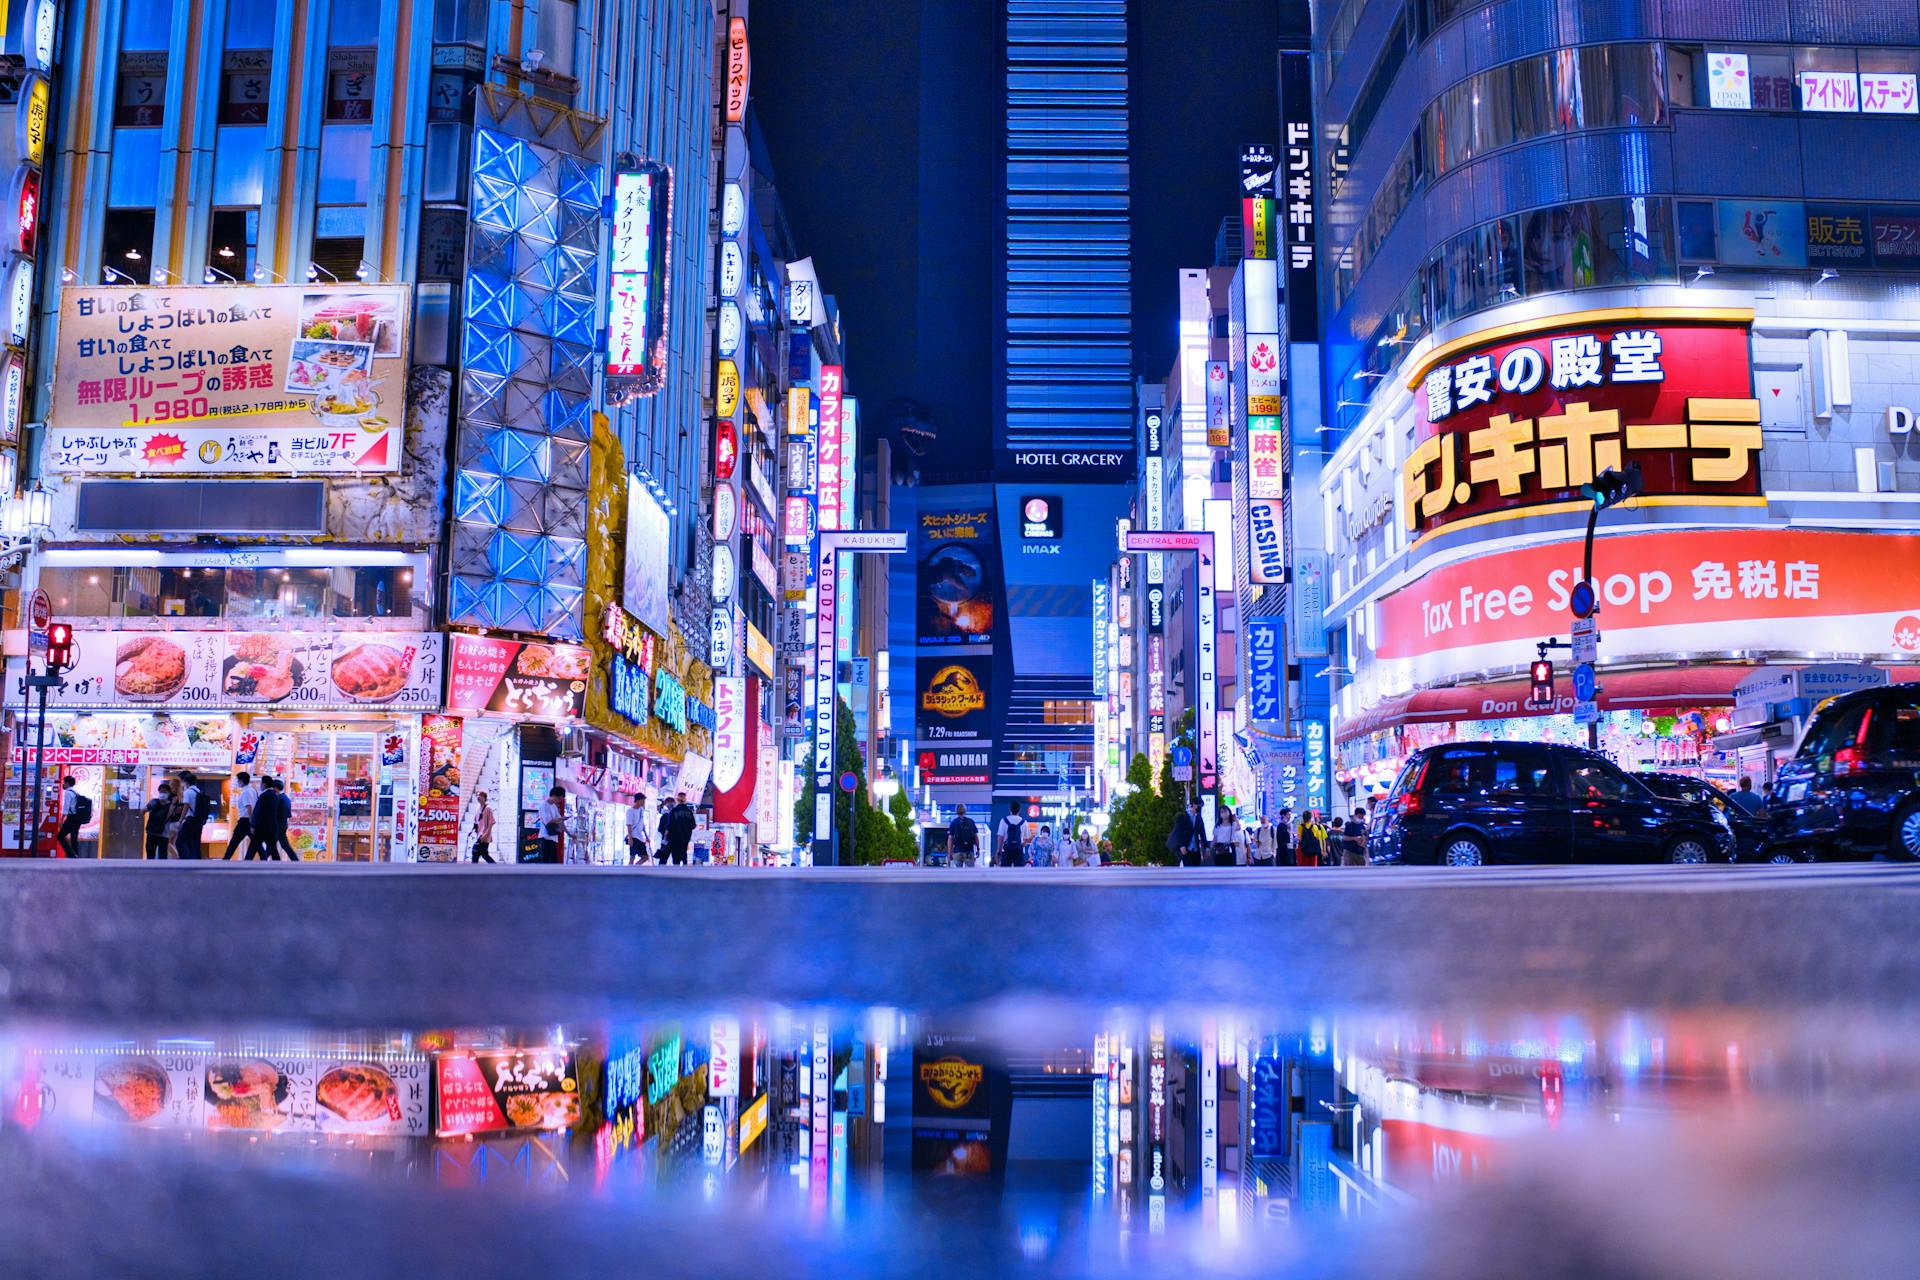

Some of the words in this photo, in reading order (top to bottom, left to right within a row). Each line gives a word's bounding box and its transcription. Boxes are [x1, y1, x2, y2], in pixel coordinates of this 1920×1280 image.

[1805, 78, 1856, 109] アイドル
[1863, 78, 1914, 110] ステージ
[620, 192, 634, 262] イタリアン
[1808, 216, 1863, 244] 販売
[1875, 223, 1920, 241] ブラン
[77, 293, 171, 316] 甘いの食べて
[118, 303, 272, 334] しょっぱいの食べて
[77, 334, 172, 358] 甘いの食べて
[118, 344, 273, 375] しょっぱいの食べて
[77, 363, 273, 405] 無限ループの誘惑
[1425, 330, 1664, 423] 驚安の殿堂
[720, 376, 737, 405] 虎の子
[1254, 416, 1275, 429] 4F
[62, 436, 138, 449] しゃぶしゃぶ
[147, 443, 182, 458] 食べ放題
[291, 433, 357, 450] 当ビル7F
[818, 371, 840, 530] カラオケ歌広場
[60, 453, 108, 465] スイーツ
[1015, 453, 1060, 466] HOTEL
[1061, 453, 1124, 466] GRACERY
[1254, 434, 1278, 478] 麻雀
[923, 513, 988, 527] 大ヒットシリーズ
[1022, 545, 1061, 554] IMAX
[1131, 537, 1173, 545] CENTRAL
[1175, 537, 1200, 545] ROAD
[1251, 504, 1283, 578] CASINO
[1421, 600, 1454, 638] Tax
[1460, 583, 1533, 627] Free
[1691, 559, 1821, 601] 免税店
[820, 569, 833, 682] GODZILLA
[421, 635, 437, 685] かつ丼
[458, 643, 508, 659] お好み焼き
[1095, 620, 1107, 690] カラオケランド
[457, 659, 506, 673] もんじゃ焼き
[1253, 627, 1277, 716] カラオケ
[454, 673, 496, 688] 焼きそば
[787, 670, 800, 701] 海の家
[1804, 673, 1881, 684] 安全安心ステーション
[182, 686, 218, 702] 500円
[290, 686, 327, 702] 500円
[400, 687, 438, 703] 550円
[717, 684, 733, 749] トラノコ
[1481, 699, 1518, 715] Don
[819, 696, 831, 751] ROAD
[1151, 715, 1164, 723] 4F
[1151, 724, 1164, 732] 3F
[928, 726, 946, 738] 7.29
[240, 733, 258, 753] 氷
[939, 753, 989, 767] MARUHAN
[1307, 721, 1324, 793] カラオケ
[1308, 795, 1324, 808] B1
